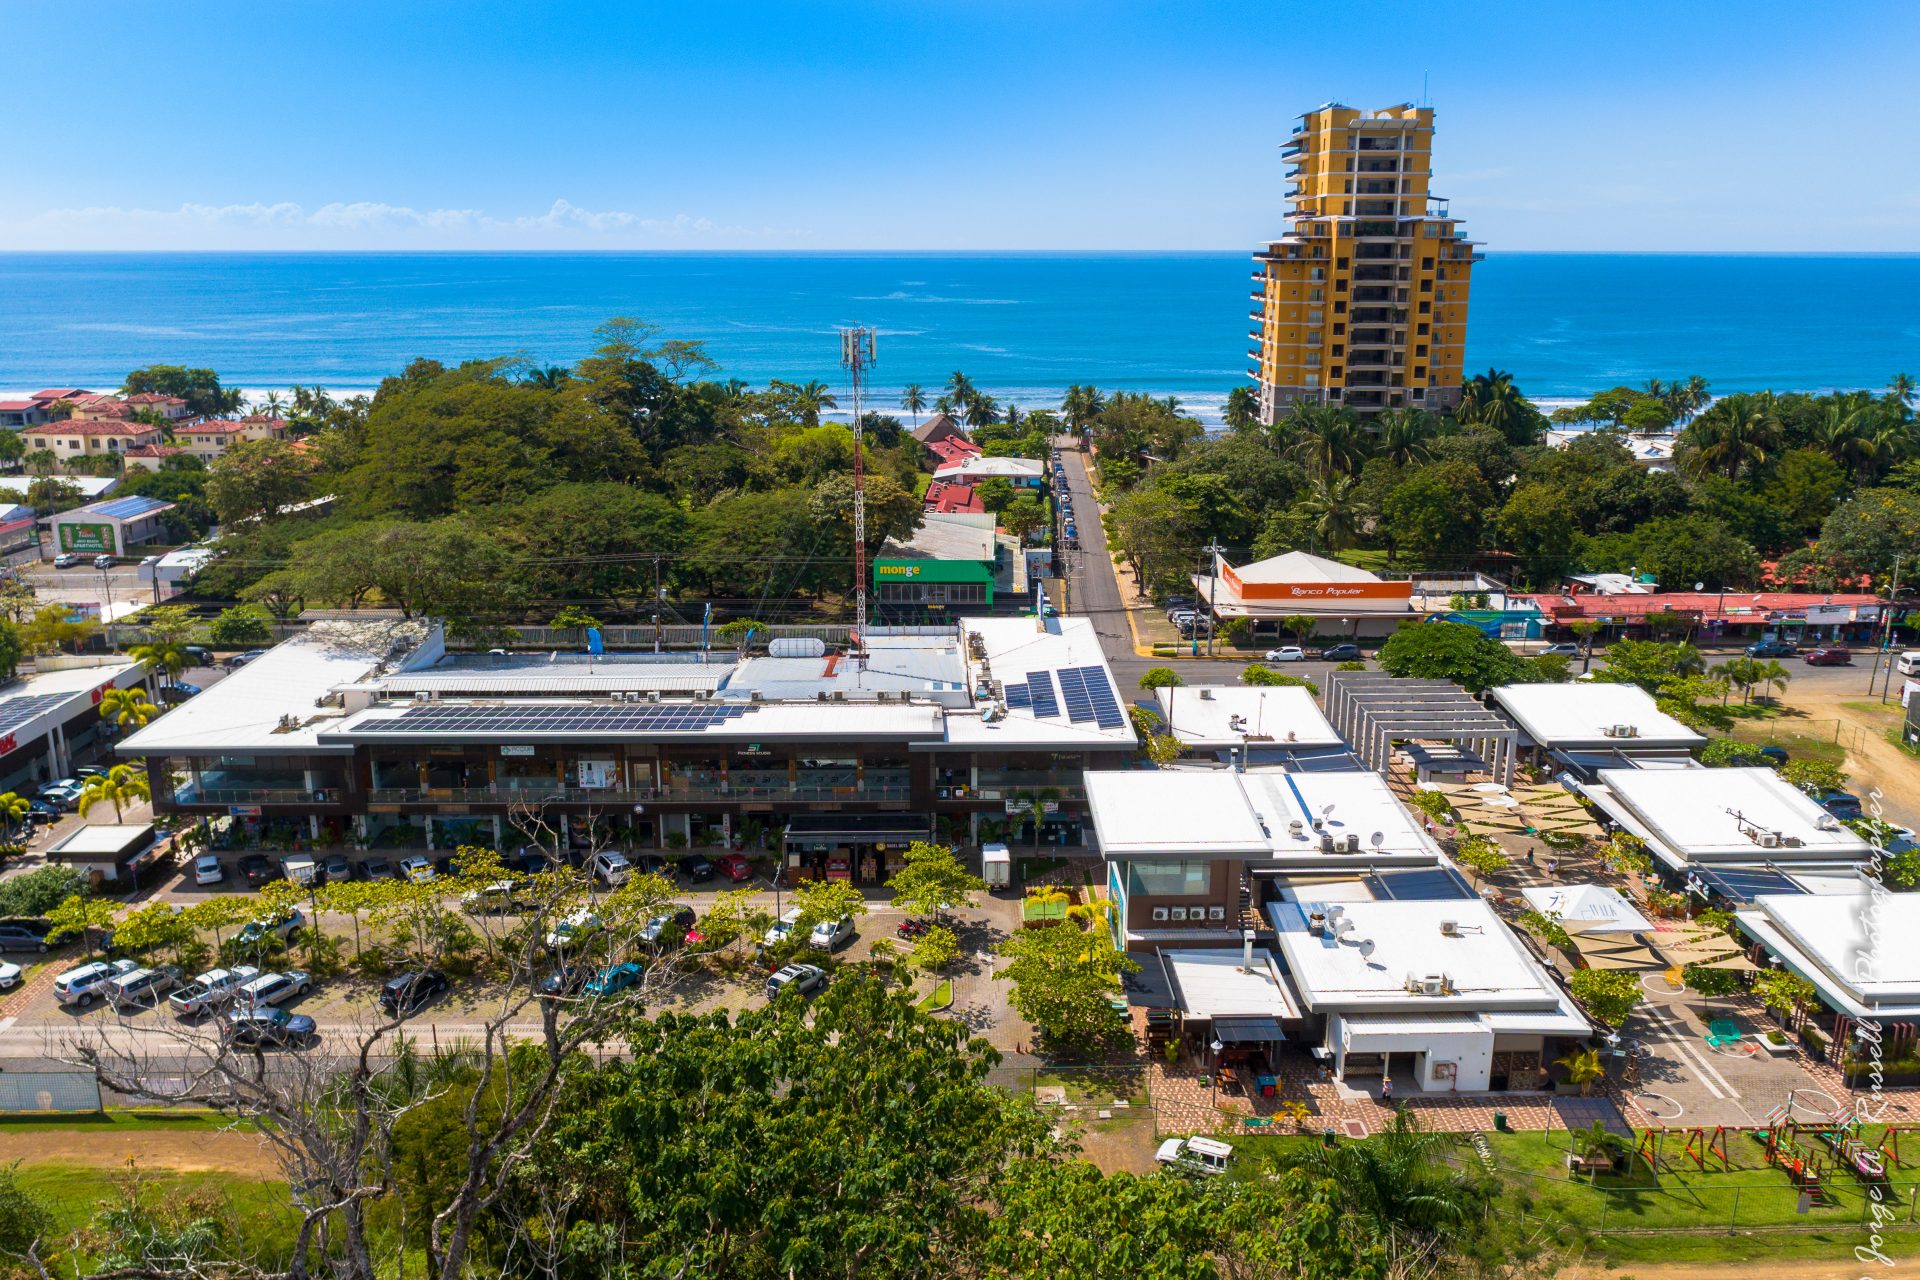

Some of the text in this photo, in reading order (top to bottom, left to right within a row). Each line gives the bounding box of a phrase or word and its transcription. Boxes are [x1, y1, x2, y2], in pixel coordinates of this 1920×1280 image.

[880, 566, 920, 577] monge
[1291, 586, 1364, 596] Banco Popular
